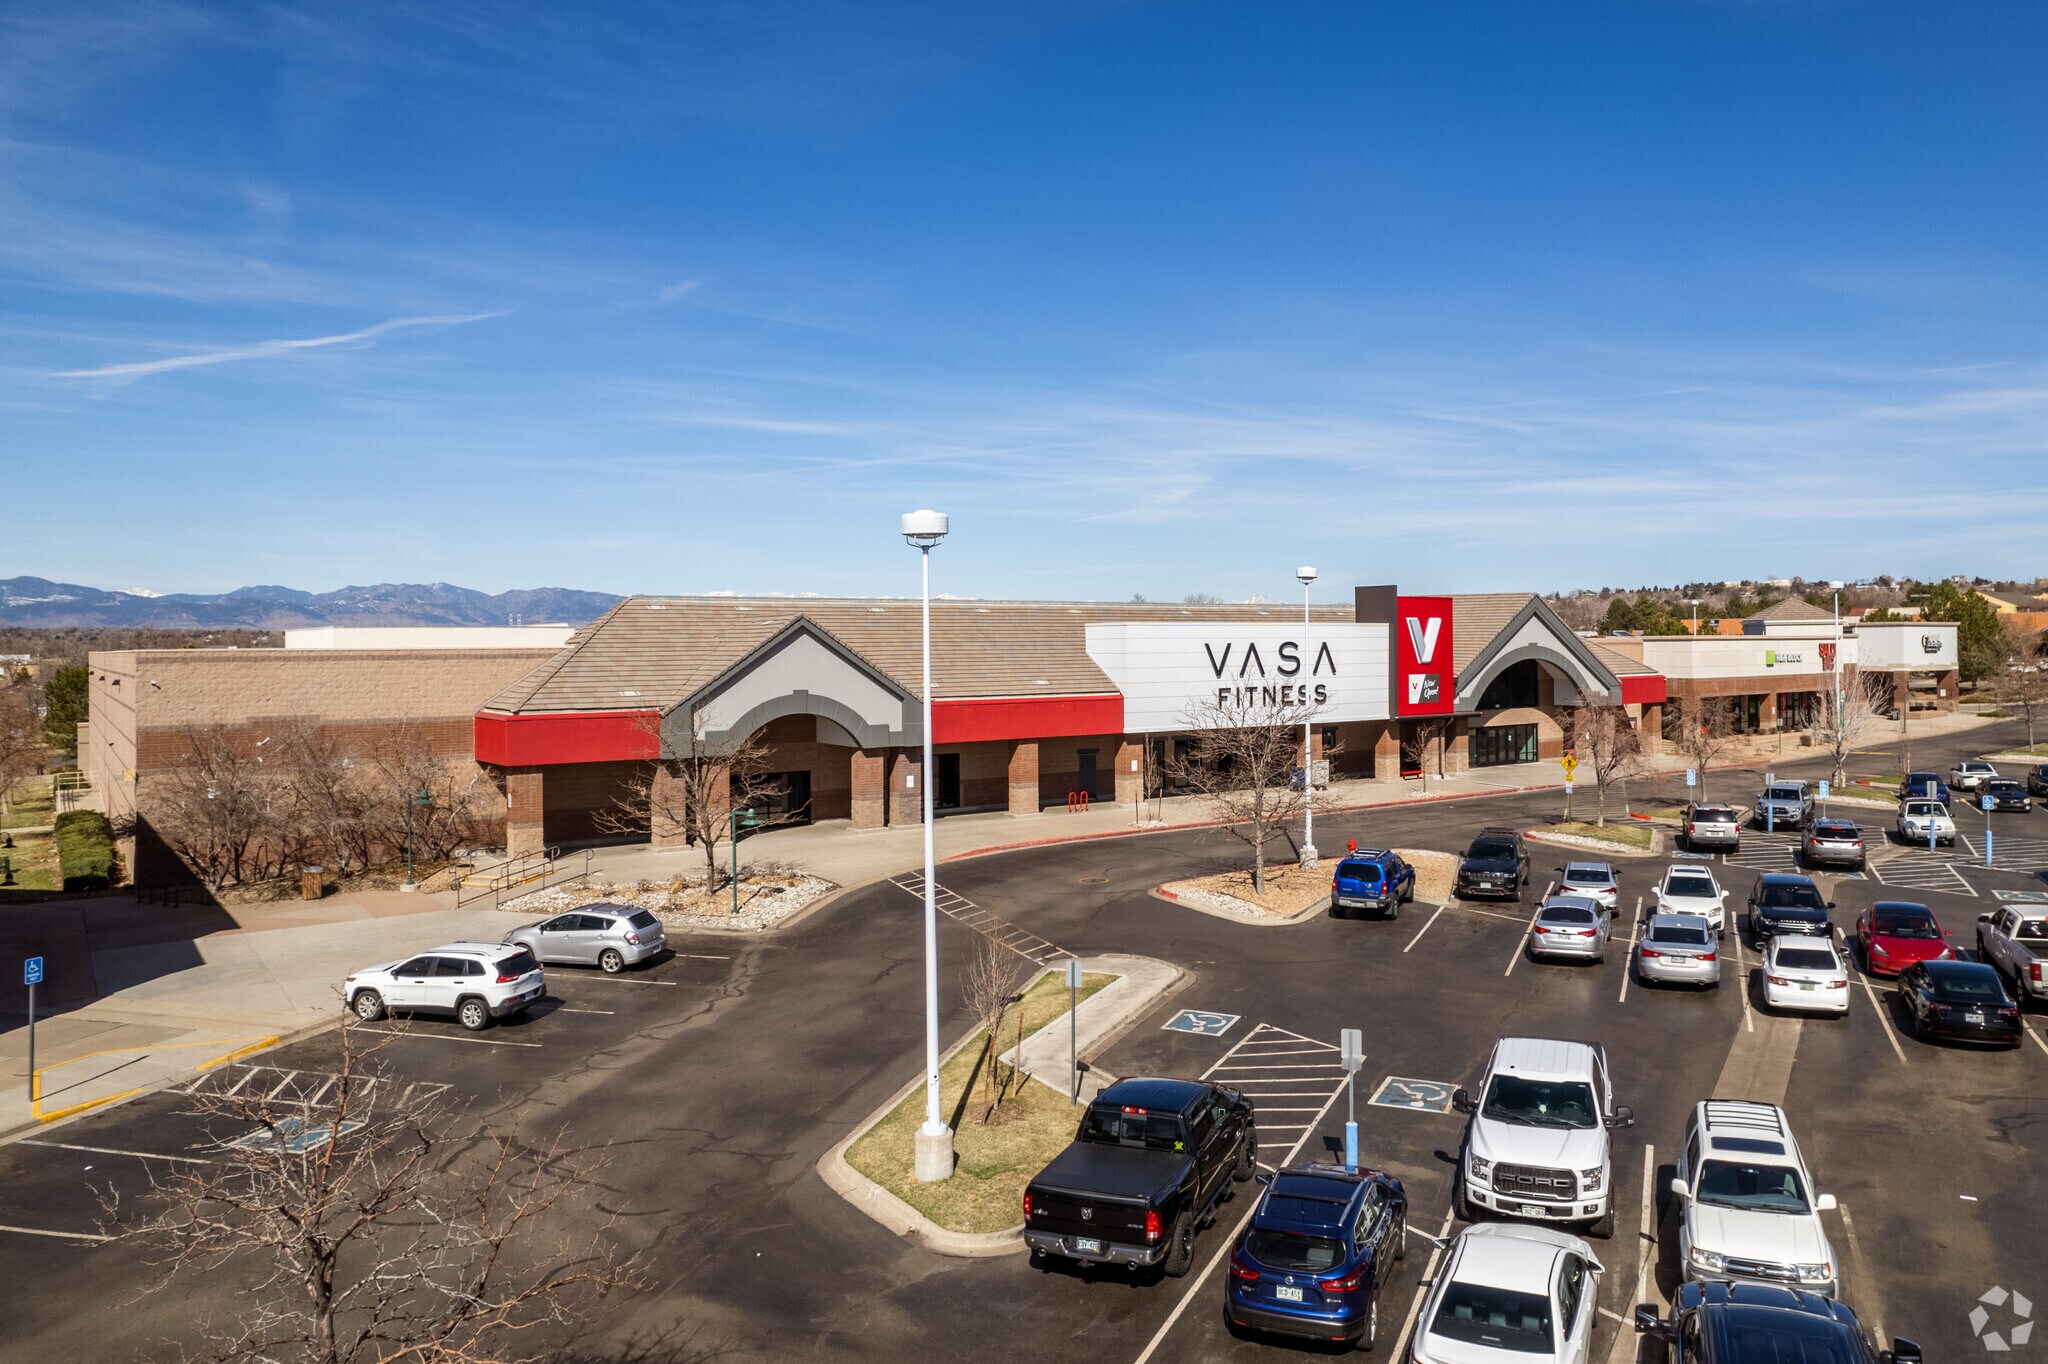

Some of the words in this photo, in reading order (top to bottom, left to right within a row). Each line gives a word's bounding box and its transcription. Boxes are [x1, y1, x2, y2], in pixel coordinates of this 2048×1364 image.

[1406, 617, 1442, 664] V
[1204, 641, 1337, 679] VASA
[1218, 684, 1328, 709] FITNESS
[1424, 680, 1436, 689] New
[1499, 1173, 1571, 1188] FORD
